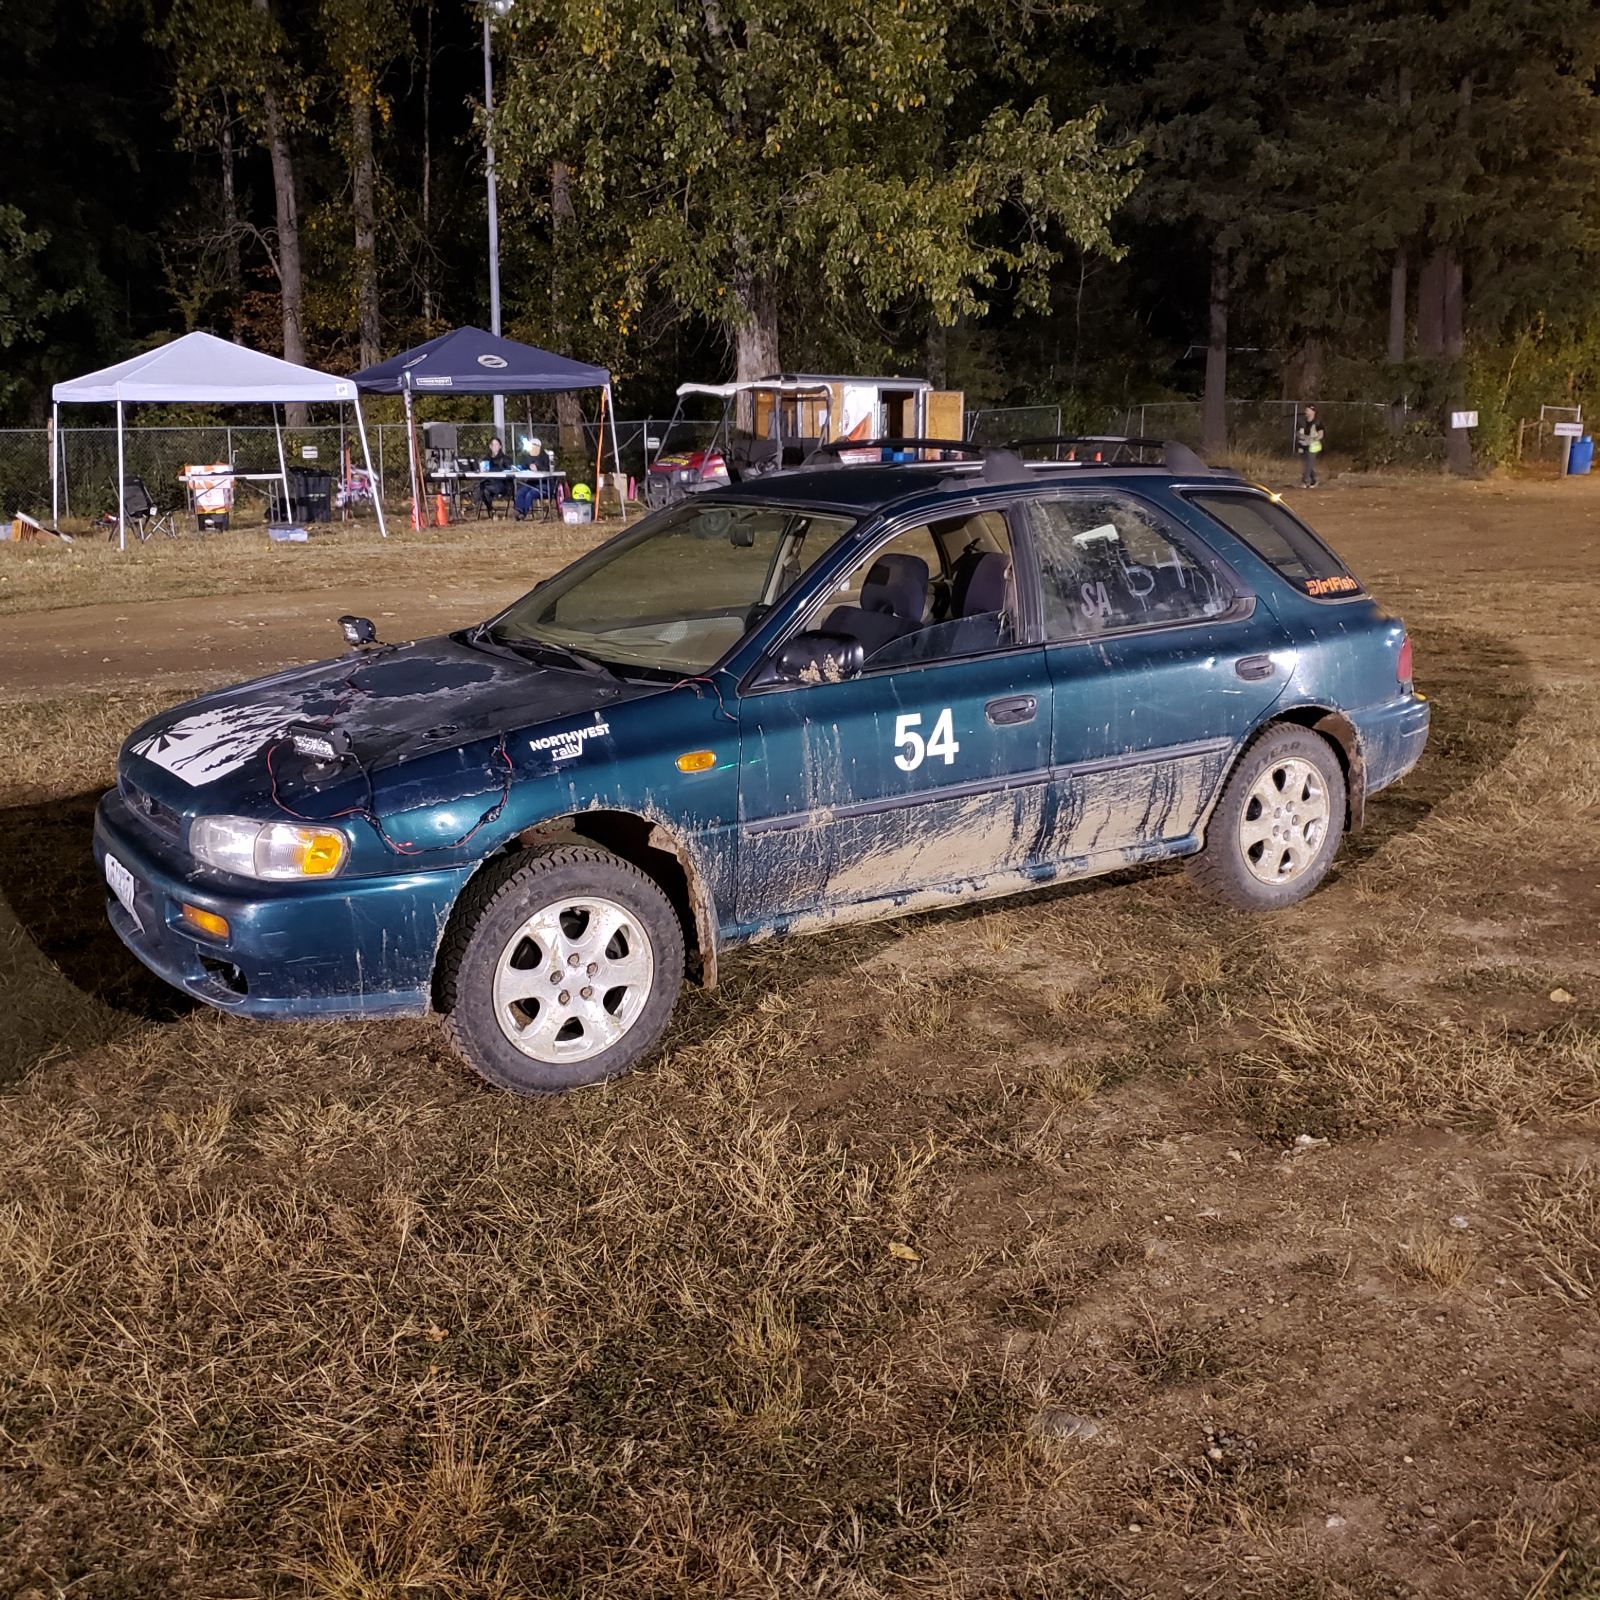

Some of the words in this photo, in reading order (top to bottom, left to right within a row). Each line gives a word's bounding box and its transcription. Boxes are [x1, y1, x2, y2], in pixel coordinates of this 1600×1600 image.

[1080, 581, 1113, 618] SA
[1305, 576, 1358, 596] DirtFish
[529, 723, 610, 752] NORTHWEST
[551, 743, 583, 761] rally
[894, 708, 960, 771] 54
